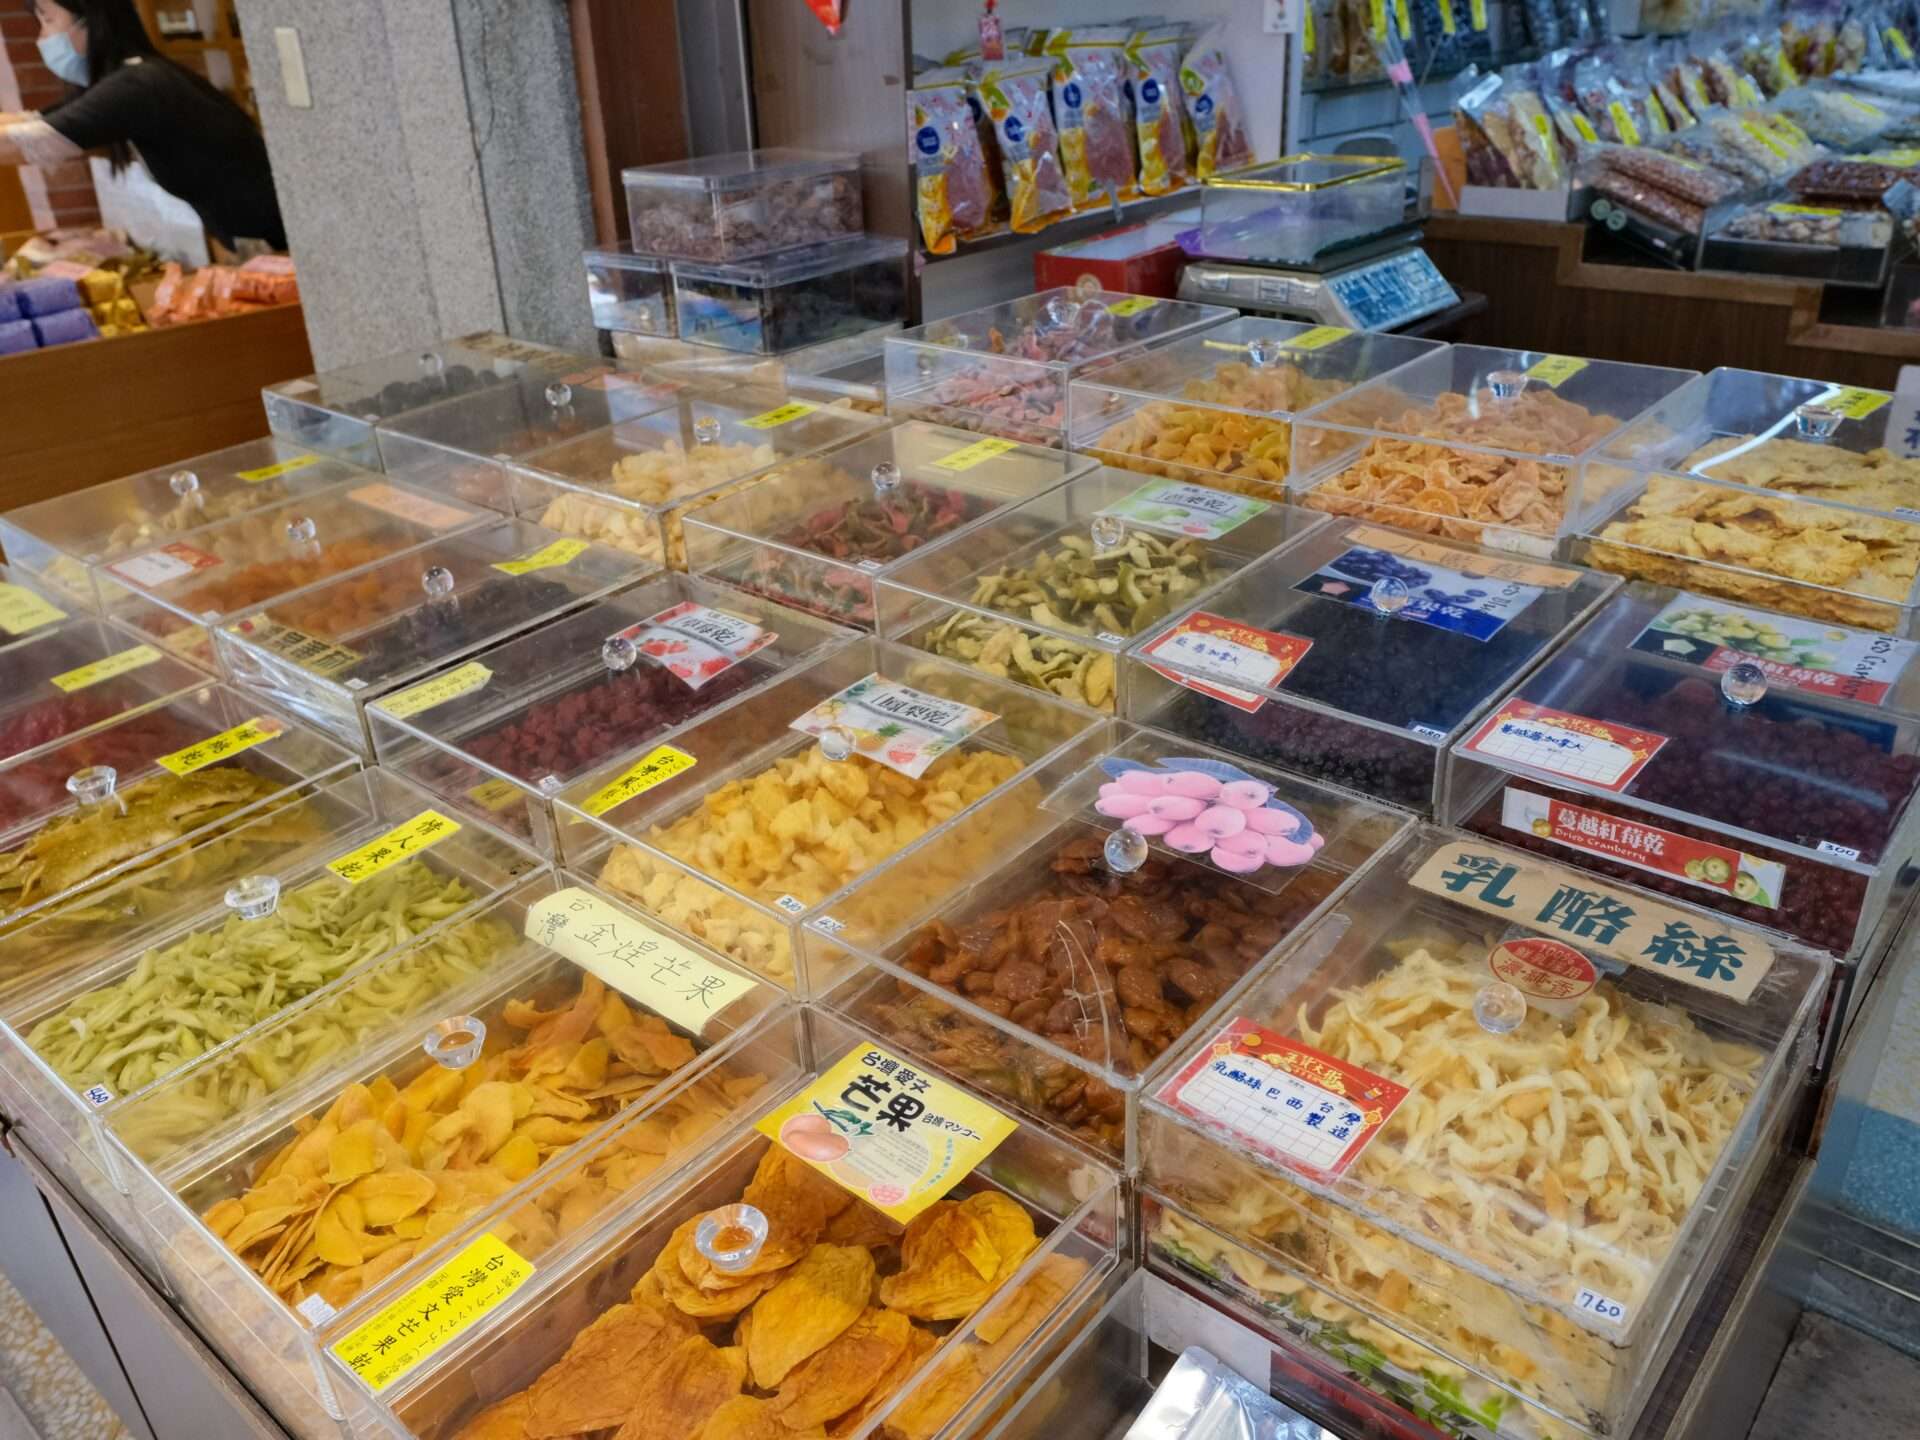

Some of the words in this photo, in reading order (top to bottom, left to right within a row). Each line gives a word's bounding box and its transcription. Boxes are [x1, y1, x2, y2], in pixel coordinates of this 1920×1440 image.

[336, 818, 444, 878] 情人果乾
[1586, 837, 1647, 863] Cranberry
[1441, 853, 1748, 982] 乳酪絲
[861, 1050, 932, 1095] 台灣愛文
[840, 1073, 926, 1133] 芒果
[348, 1253, 505, 1376] 台灣愛文芒果乾
[1581, 1292, 1621, 1318] 760
